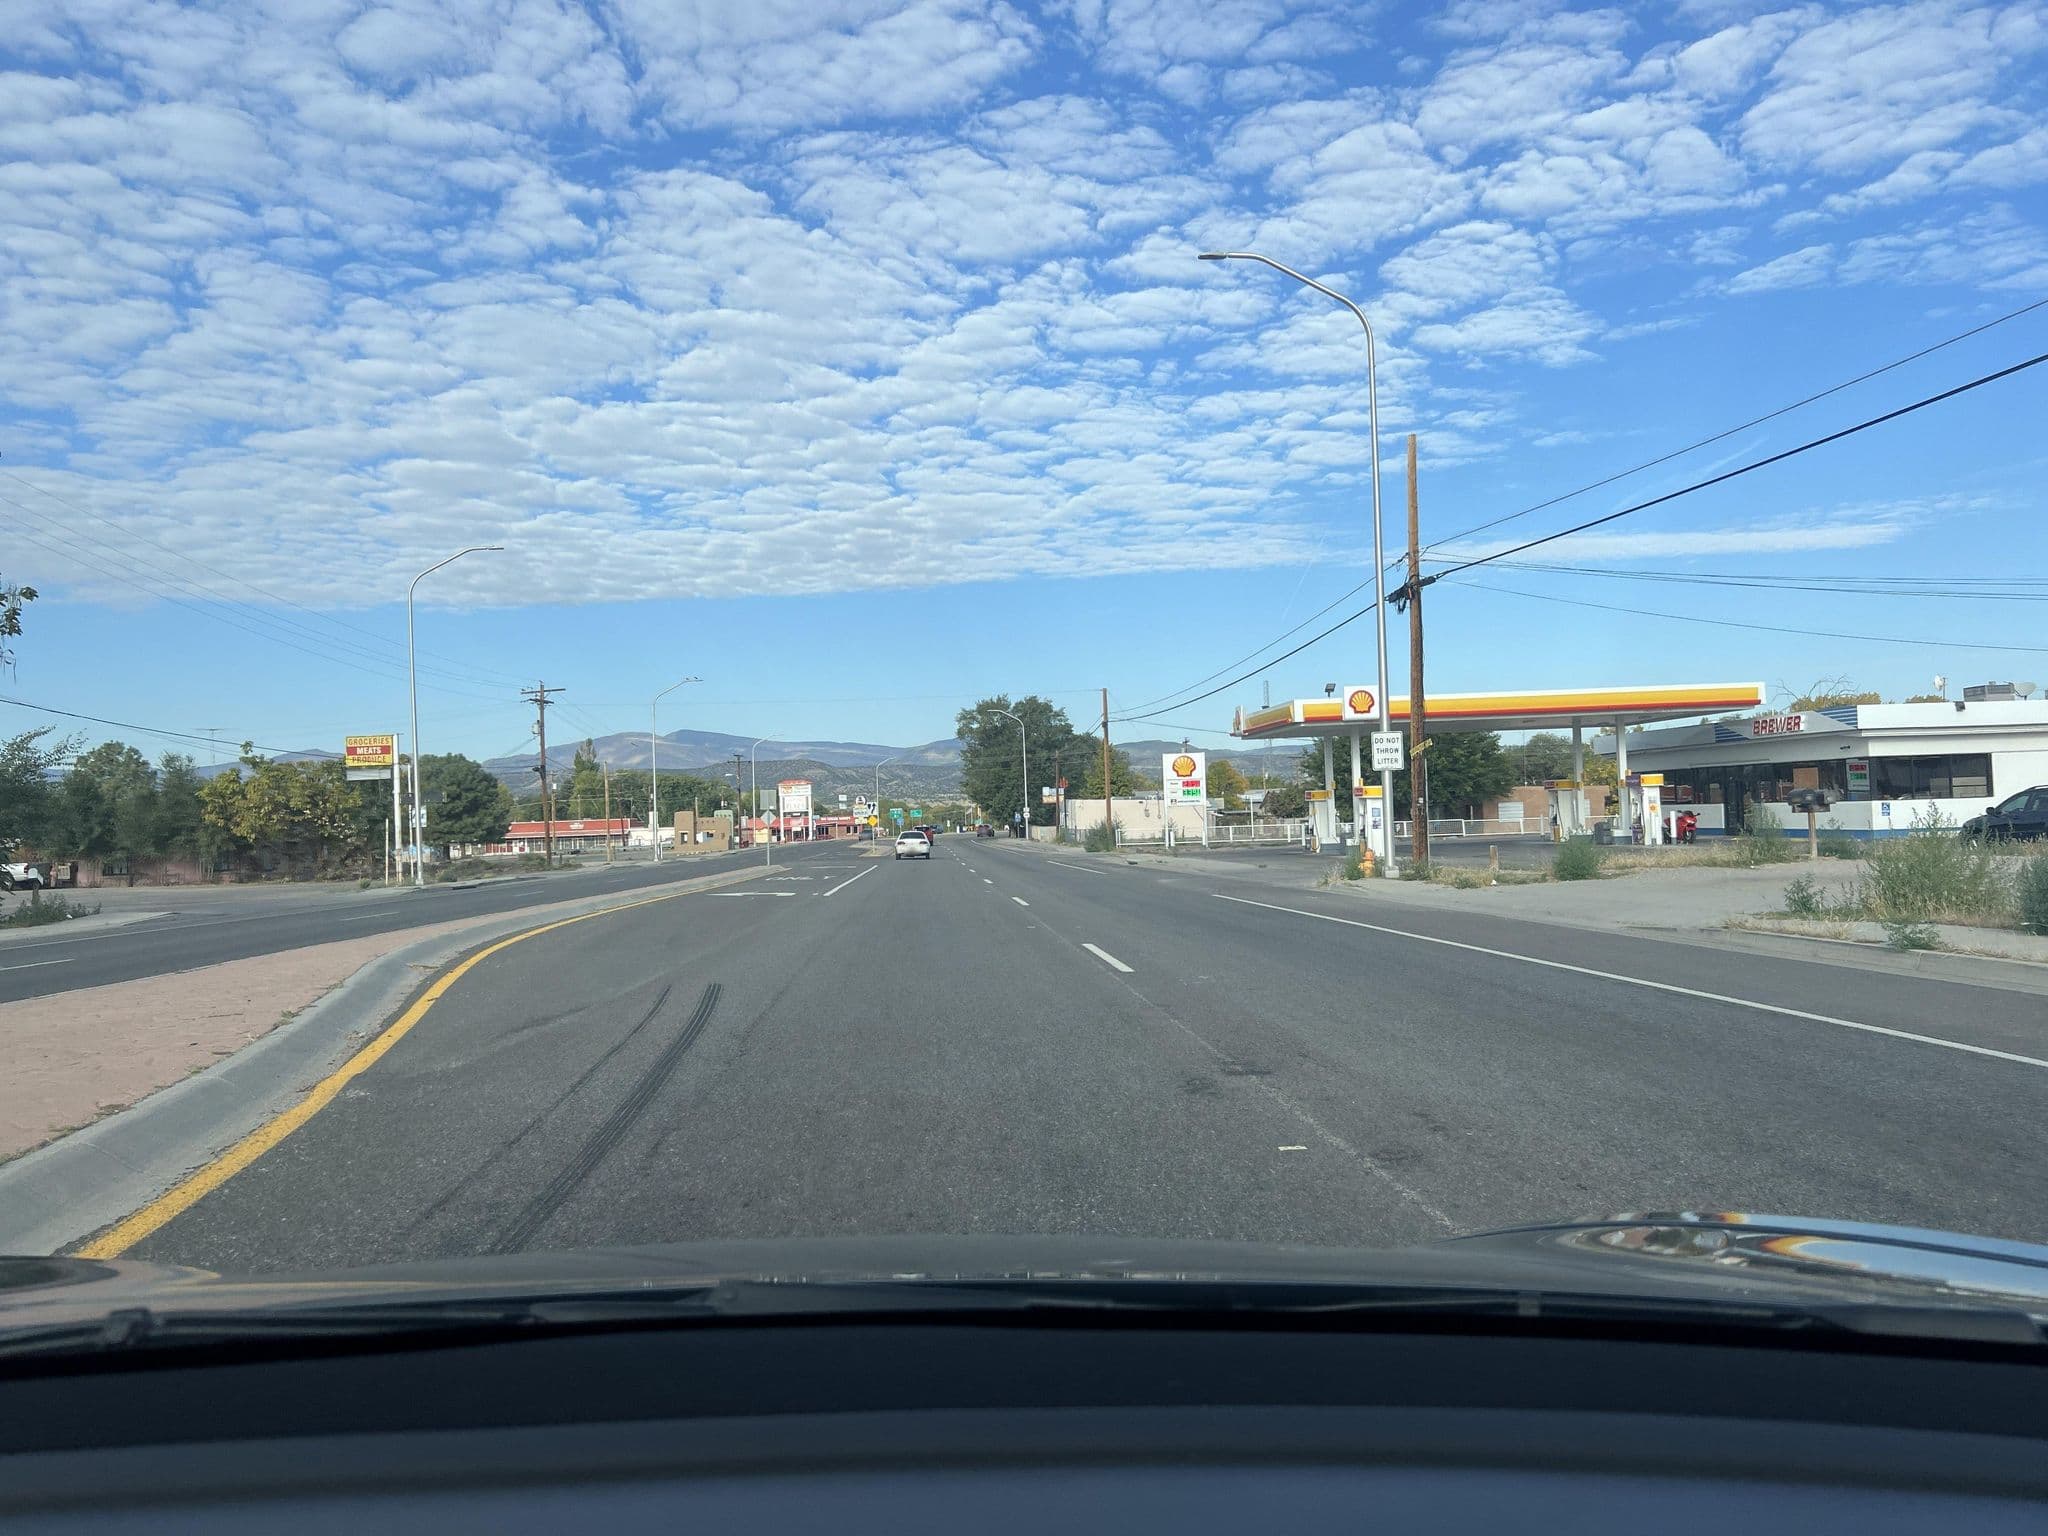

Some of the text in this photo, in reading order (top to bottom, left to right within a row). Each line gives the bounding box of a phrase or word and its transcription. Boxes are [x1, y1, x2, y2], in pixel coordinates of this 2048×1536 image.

[1753, 715, 1801, 735] BREWER
[348, 737, 390, 745] GROCERIES
[356, 746, 382, 755] MEATS
[352, 755, 387, 764] PRODUCE
